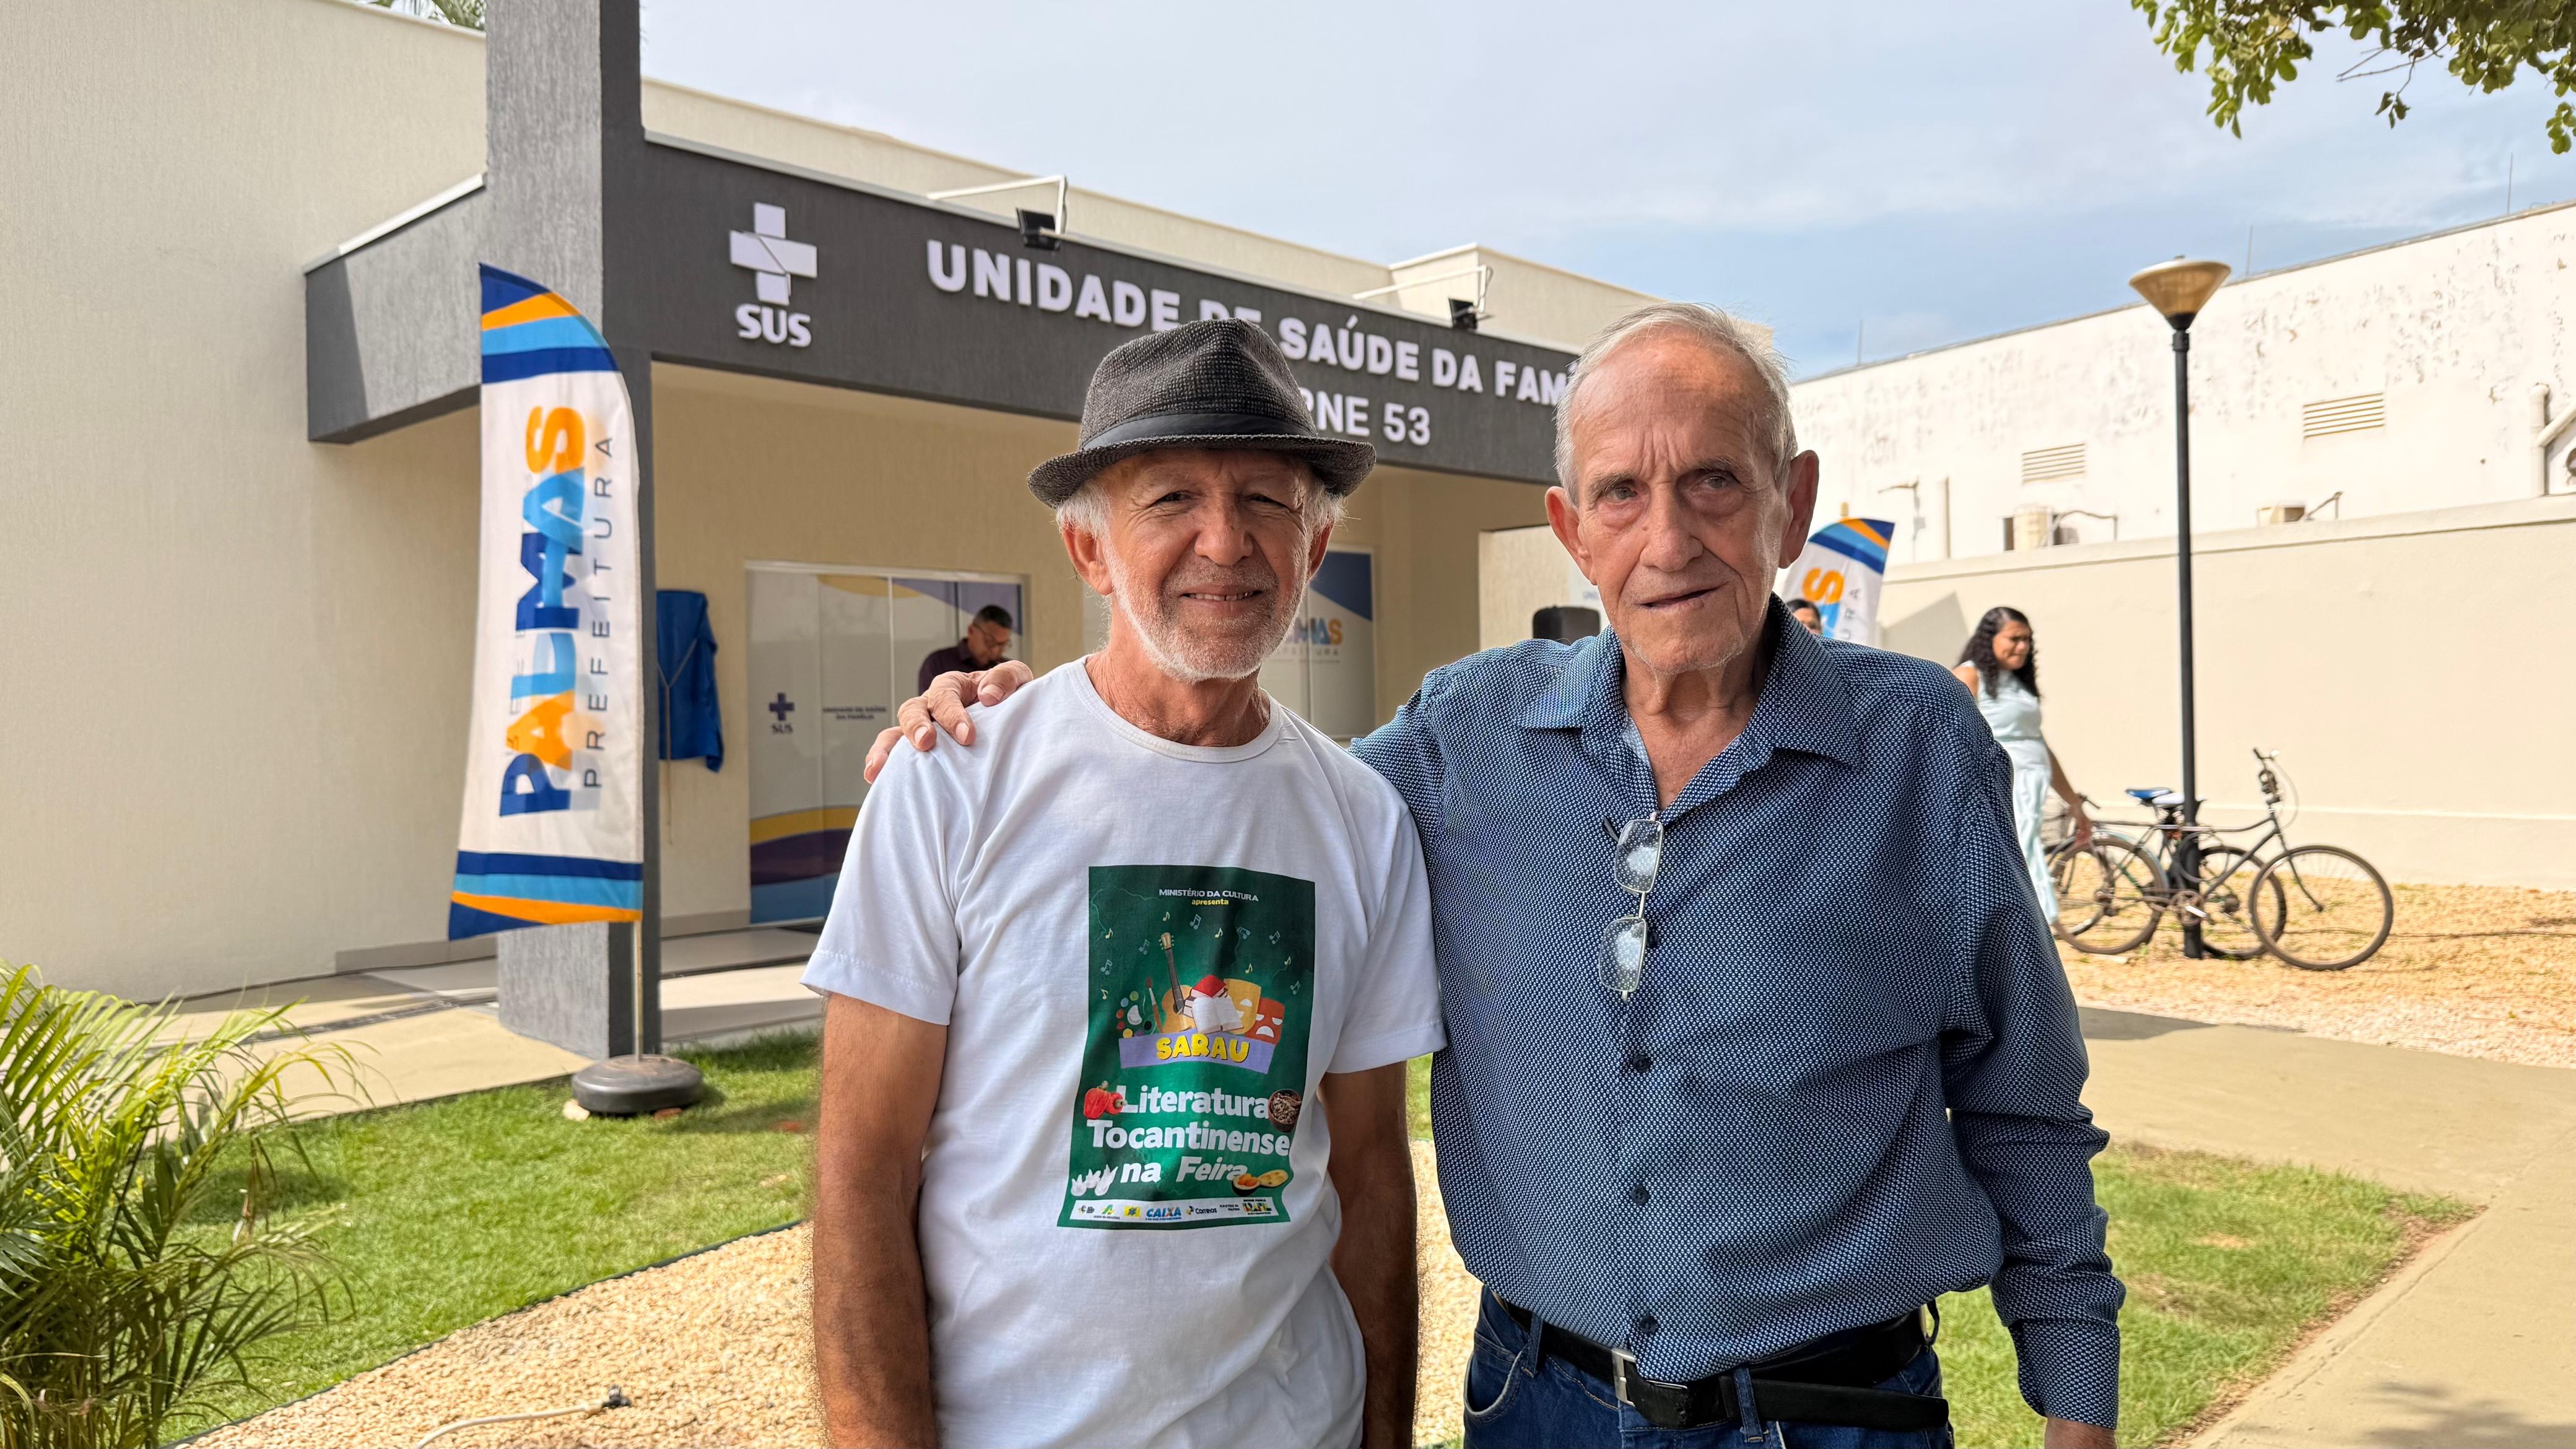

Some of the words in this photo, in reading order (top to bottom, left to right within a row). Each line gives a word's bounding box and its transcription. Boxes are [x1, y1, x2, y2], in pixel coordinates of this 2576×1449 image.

[734, 302, 812, 348] SUS
[926, 240, 1180, 331] UNIDADE
[1278, 315, 1420, 381] SAÚDE
[1432, 348, 1484, 393] DA
[1494, 357, 1578, 407] FAM
[1299, 387, 1370, 437] NE
[1383, 402, 1431, 445] 53
[499, 406, 586, 817] PALMAS
[584, 437, 613, 788] PREFEITURA
[1159, 888, 1206, 897] MINISTÉRIO
[1222, 890, 1259, 902] CULTURA
[1155, 1033, 1250, 1063] SARAU
[1115, 1085, 1270, 1120] Literatura
[1086, 1120, 1290, 1156] Tocantinense
[1120, 1161, 1162, 1184] na
[1175, 1155, 1248, 1183] Feira
[1146, 1206, 1182, 1217] CAIXA
